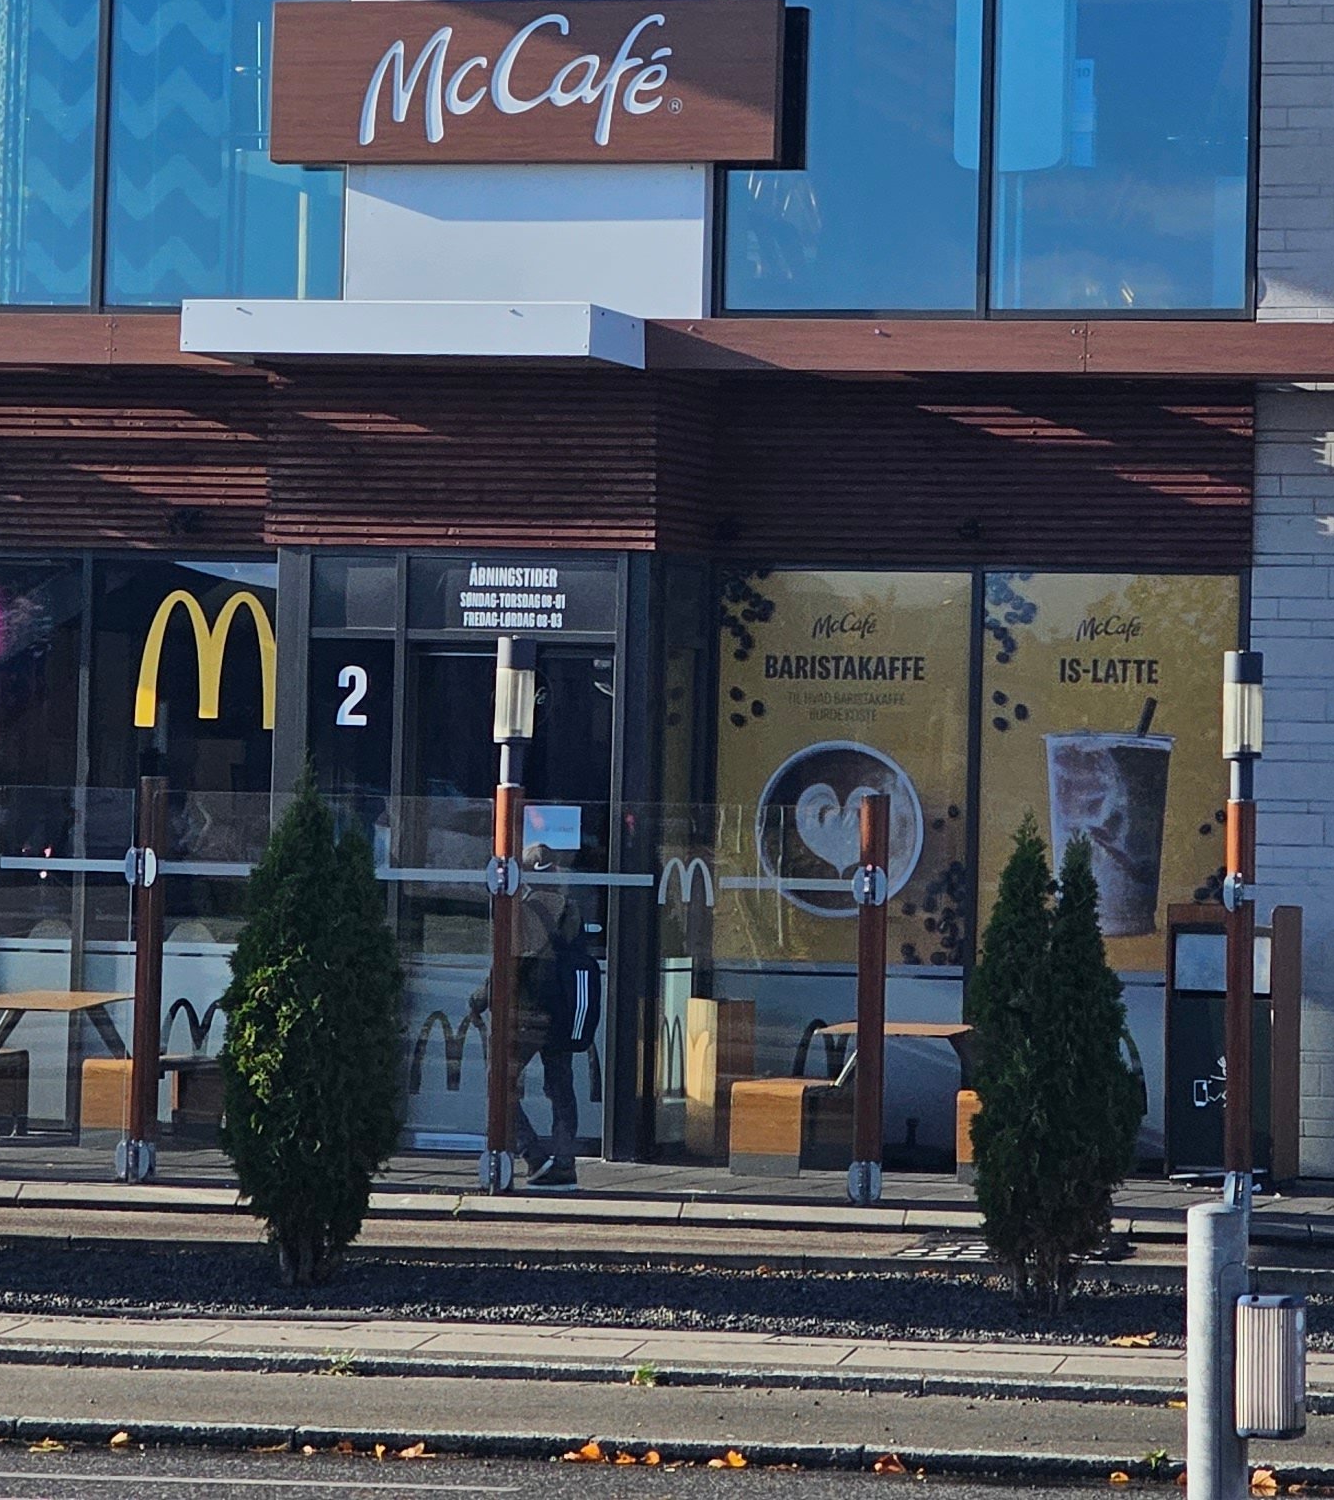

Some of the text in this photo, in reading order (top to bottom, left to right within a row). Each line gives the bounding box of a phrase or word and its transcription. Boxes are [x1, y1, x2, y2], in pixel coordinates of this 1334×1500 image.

[358, 12, 673, 146] McCafé
[469, 562, 558, 588] ÅBNINGSTIDER
[764, 655, 926, 681] BARISTAKAFFE
[1059, 658, 1160, 684] IS-LATTE
[336, 664, 369, 727] 2
